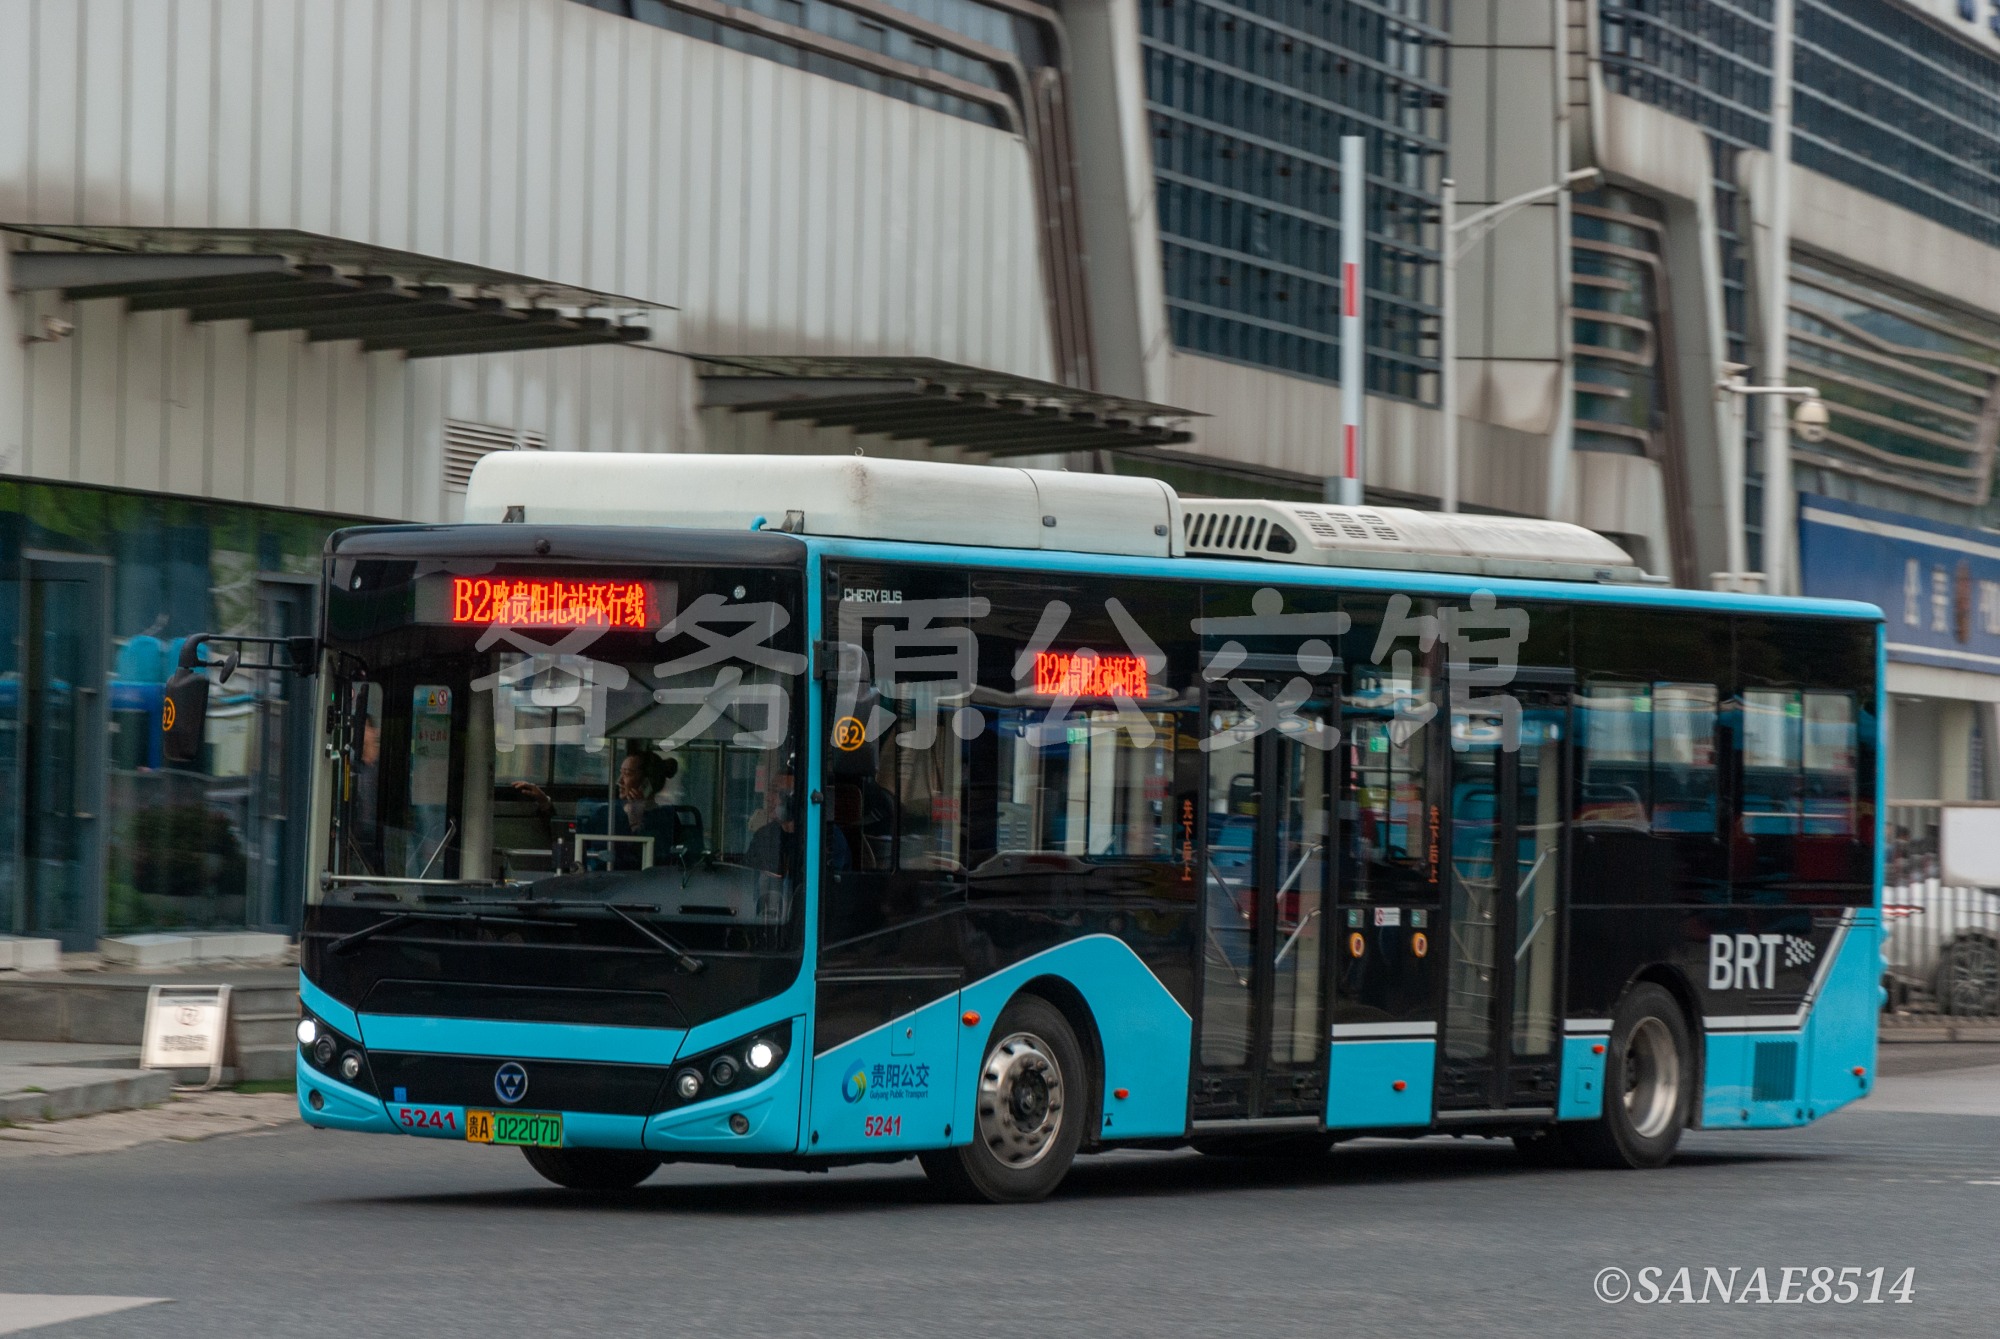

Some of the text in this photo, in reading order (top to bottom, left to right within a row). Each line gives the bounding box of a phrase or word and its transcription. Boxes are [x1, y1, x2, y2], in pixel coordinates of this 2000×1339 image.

[453, 579, 645, 627] B2路贵阳北站环行线
[844, 588, 902, 604] CHERY BUS
[839, 725, 861, 744] B2
[1708, 934, 1783, 990] BRT
[871, 1063, 930, 1089] 贵阳公交
[869, 1089, 928, 1101] Guiyang Public Transport
[400, 1108, 457, 1130] 5241
[865, 1115, 901, 1137] 5241
